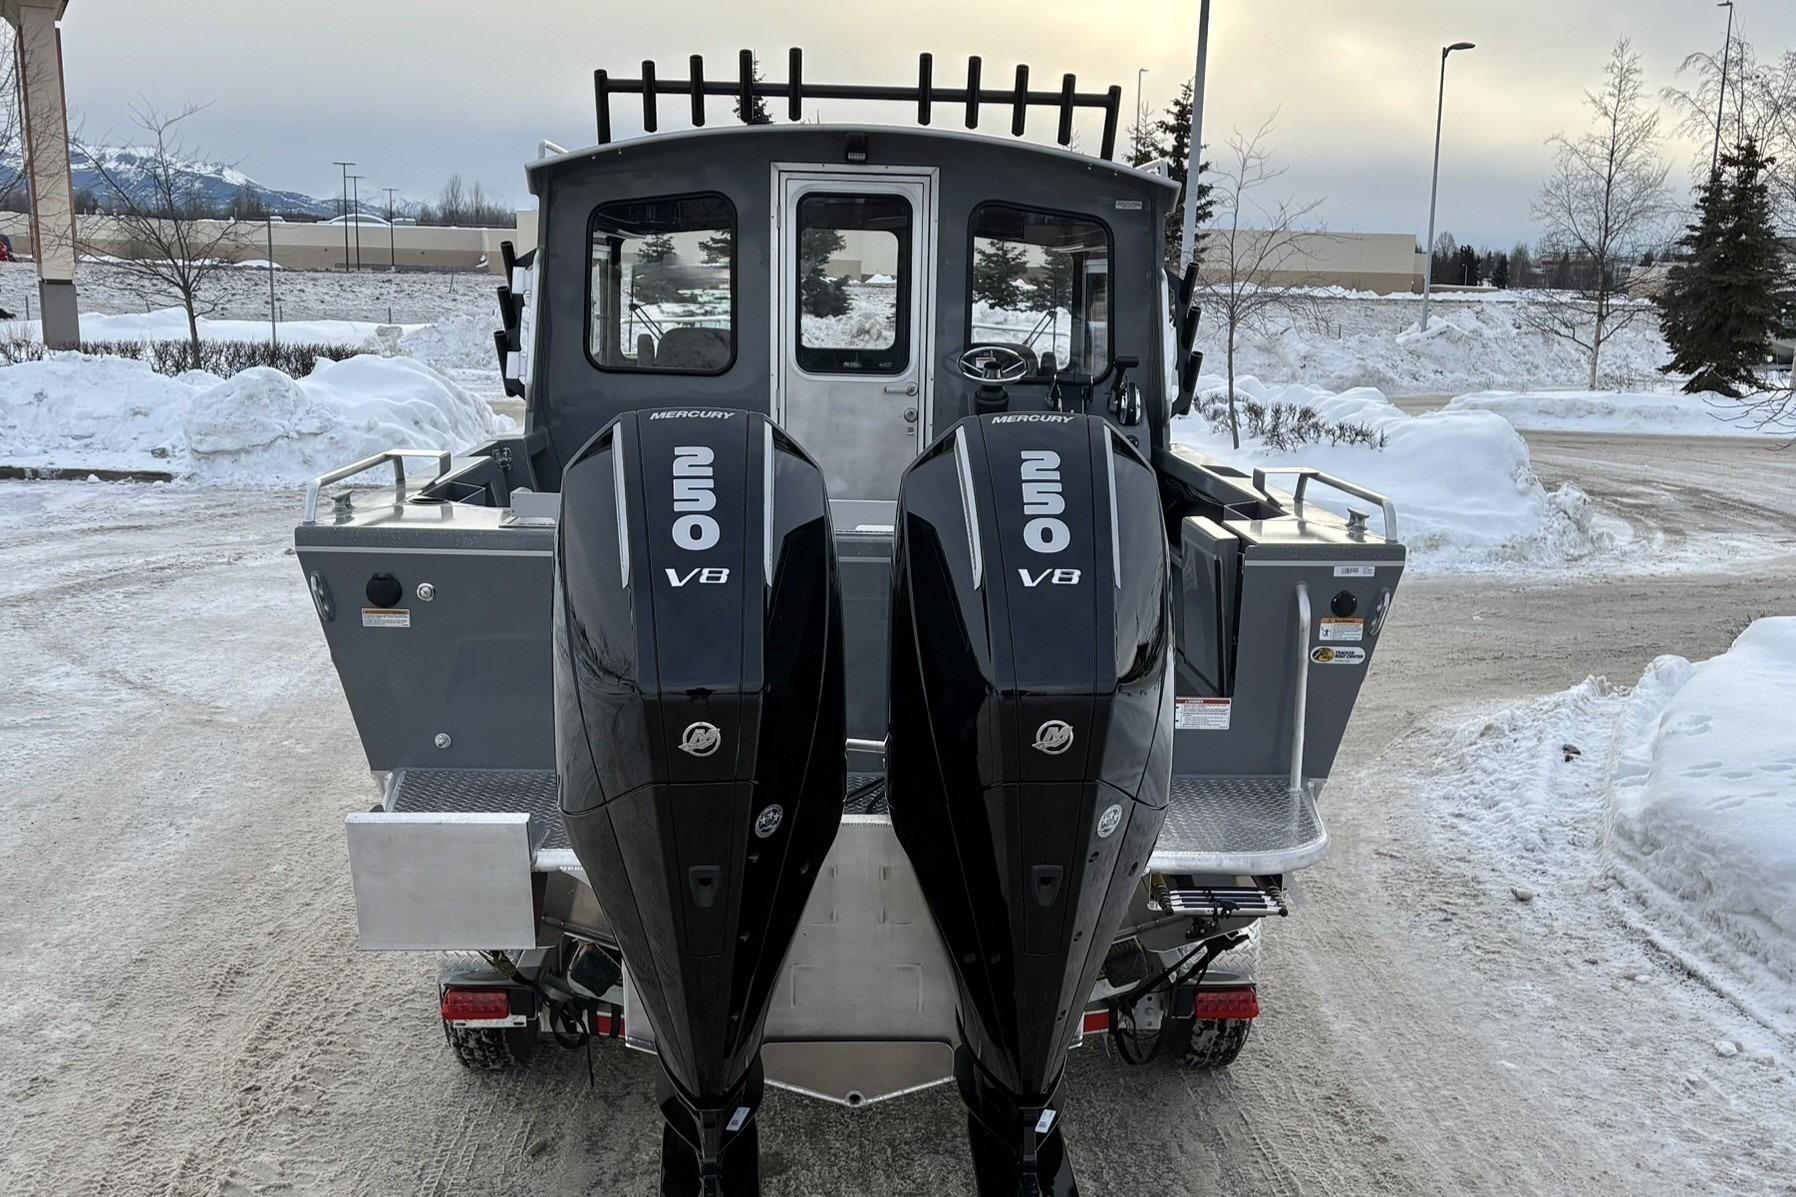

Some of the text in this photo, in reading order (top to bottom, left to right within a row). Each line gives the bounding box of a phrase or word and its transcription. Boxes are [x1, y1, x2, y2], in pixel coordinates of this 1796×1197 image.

[650, 410, 736, 421] MERCURY
[991, 414, 1074, 425] MERCURY
[671, 446, 721, 551] 250
[1020, 450, 1071, 553] 250
[665, 567, 730, 587] V8
[1018, 568, 1081, 587] V8
